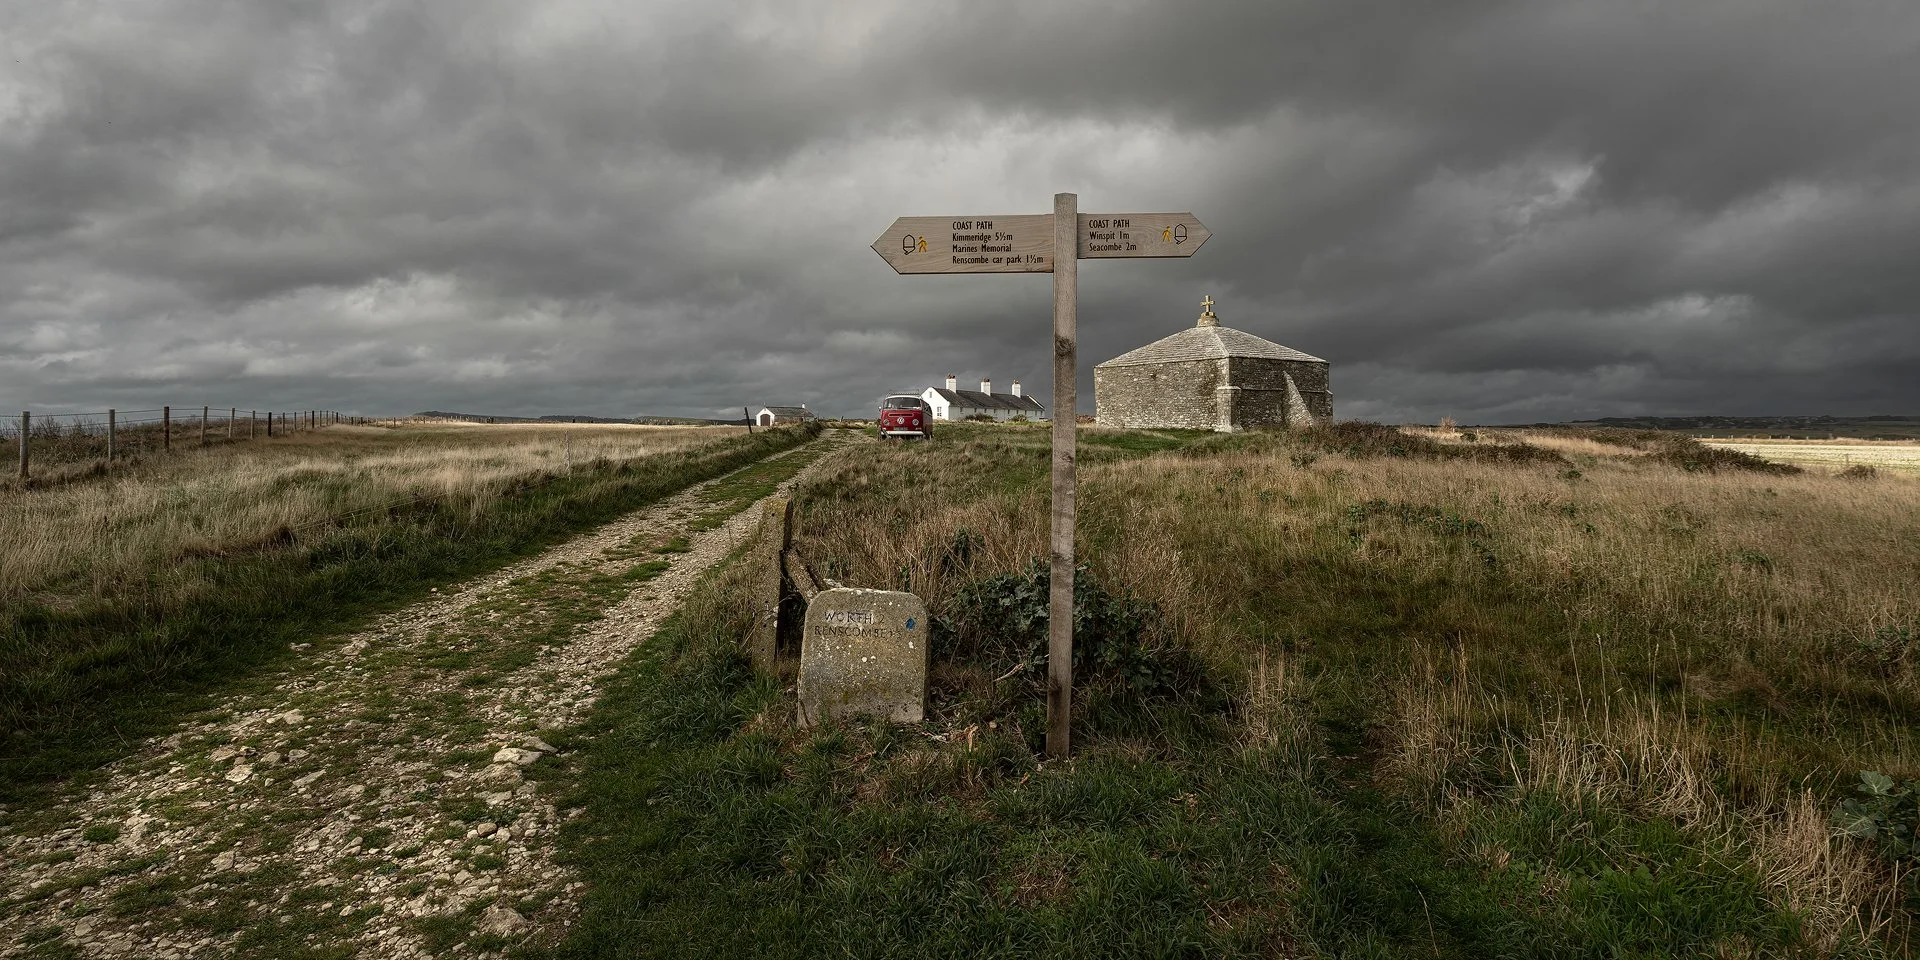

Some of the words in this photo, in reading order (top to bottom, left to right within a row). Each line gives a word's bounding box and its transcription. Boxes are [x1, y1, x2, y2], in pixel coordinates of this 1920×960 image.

[953, 221, 972, 230] COAST
[977, 221, 992, 229] PATH
[1089, 220, 1109, 228] COAST
[1113, 219, 1130, 228] PATH
[953, 233, 991, 243] Kimmeridge
[1089, 231, 1115, 242] Winspit
[1120, 231, 1129, 239] 1m
[953, 244, 977, 252] Marines
[981, 244, 1012, 252] Memorial
[1089, 243, 1122, 251] Seacombe
[953, 256, 988, 264] Renscombe
[1007, 255, 1021, 265] park
[825, 612, 872, 624] WORTH
[814, 626, 886, 638] RENSCOMBE
